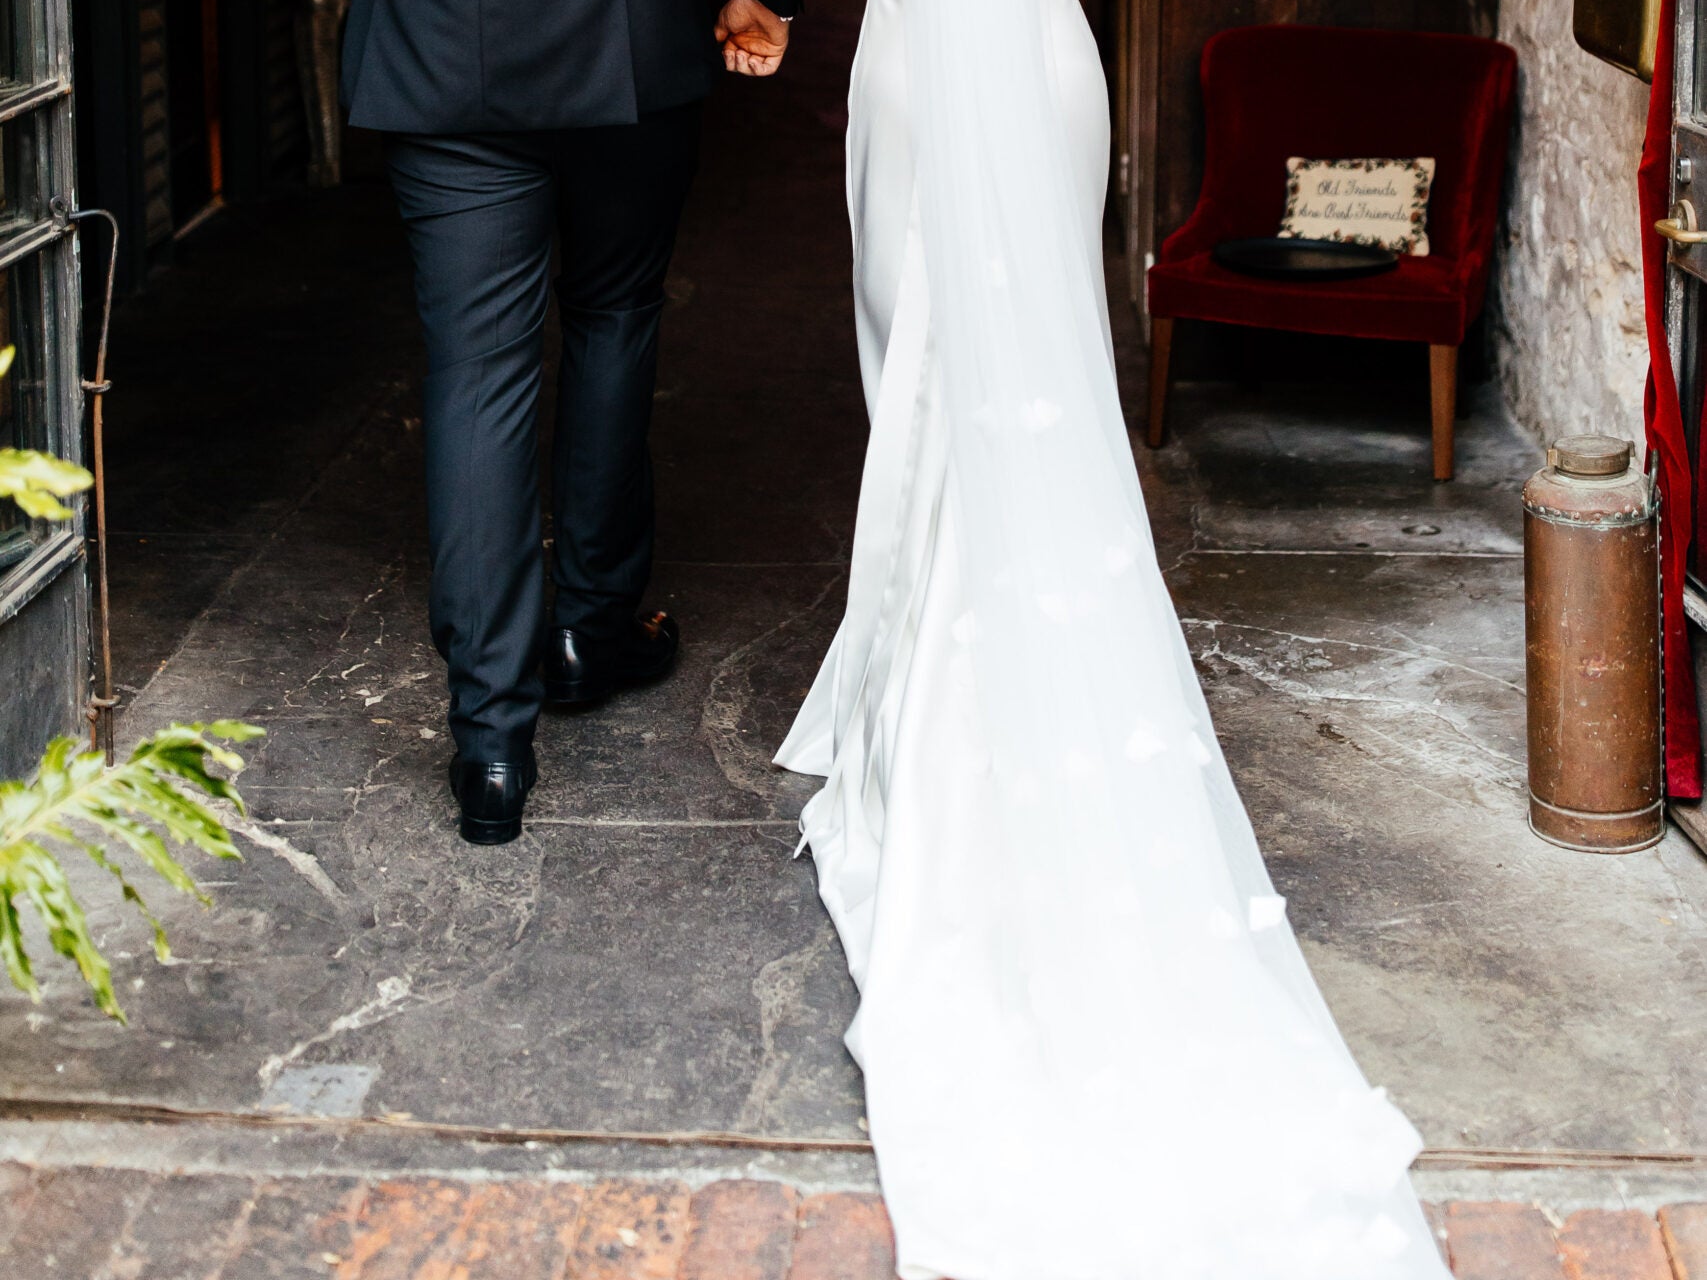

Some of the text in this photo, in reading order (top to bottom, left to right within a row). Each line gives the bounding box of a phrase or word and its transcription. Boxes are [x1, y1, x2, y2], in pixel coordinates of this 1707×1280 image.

[1317, 179, 1398, 196] Old Friends
[1355, 202, 1409, 219] Friends
